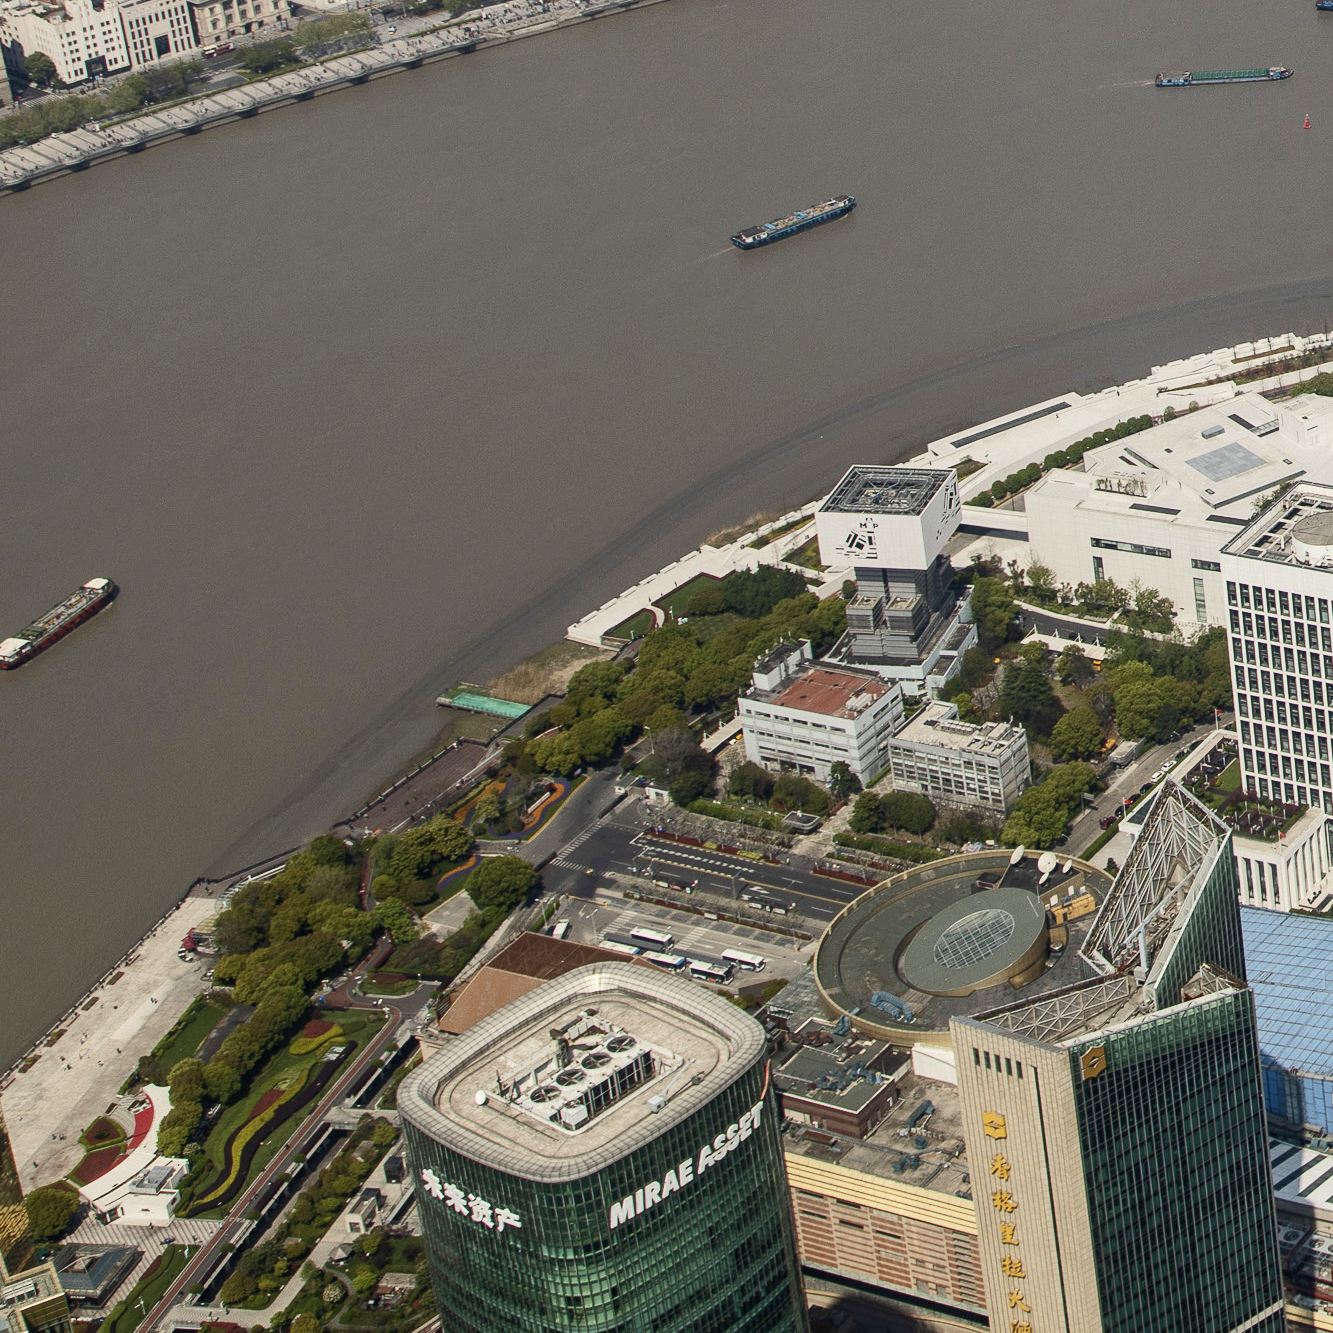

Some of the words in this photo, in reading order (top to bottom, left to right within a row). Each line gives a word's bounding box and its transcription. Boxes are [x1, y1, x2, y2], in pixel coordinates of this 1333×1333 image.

[422, 1168, 522, 1232] 未来资产
[610, 1158, 694, 1229] MIRAE
[698, 1100, 764, 1174] ASSET
